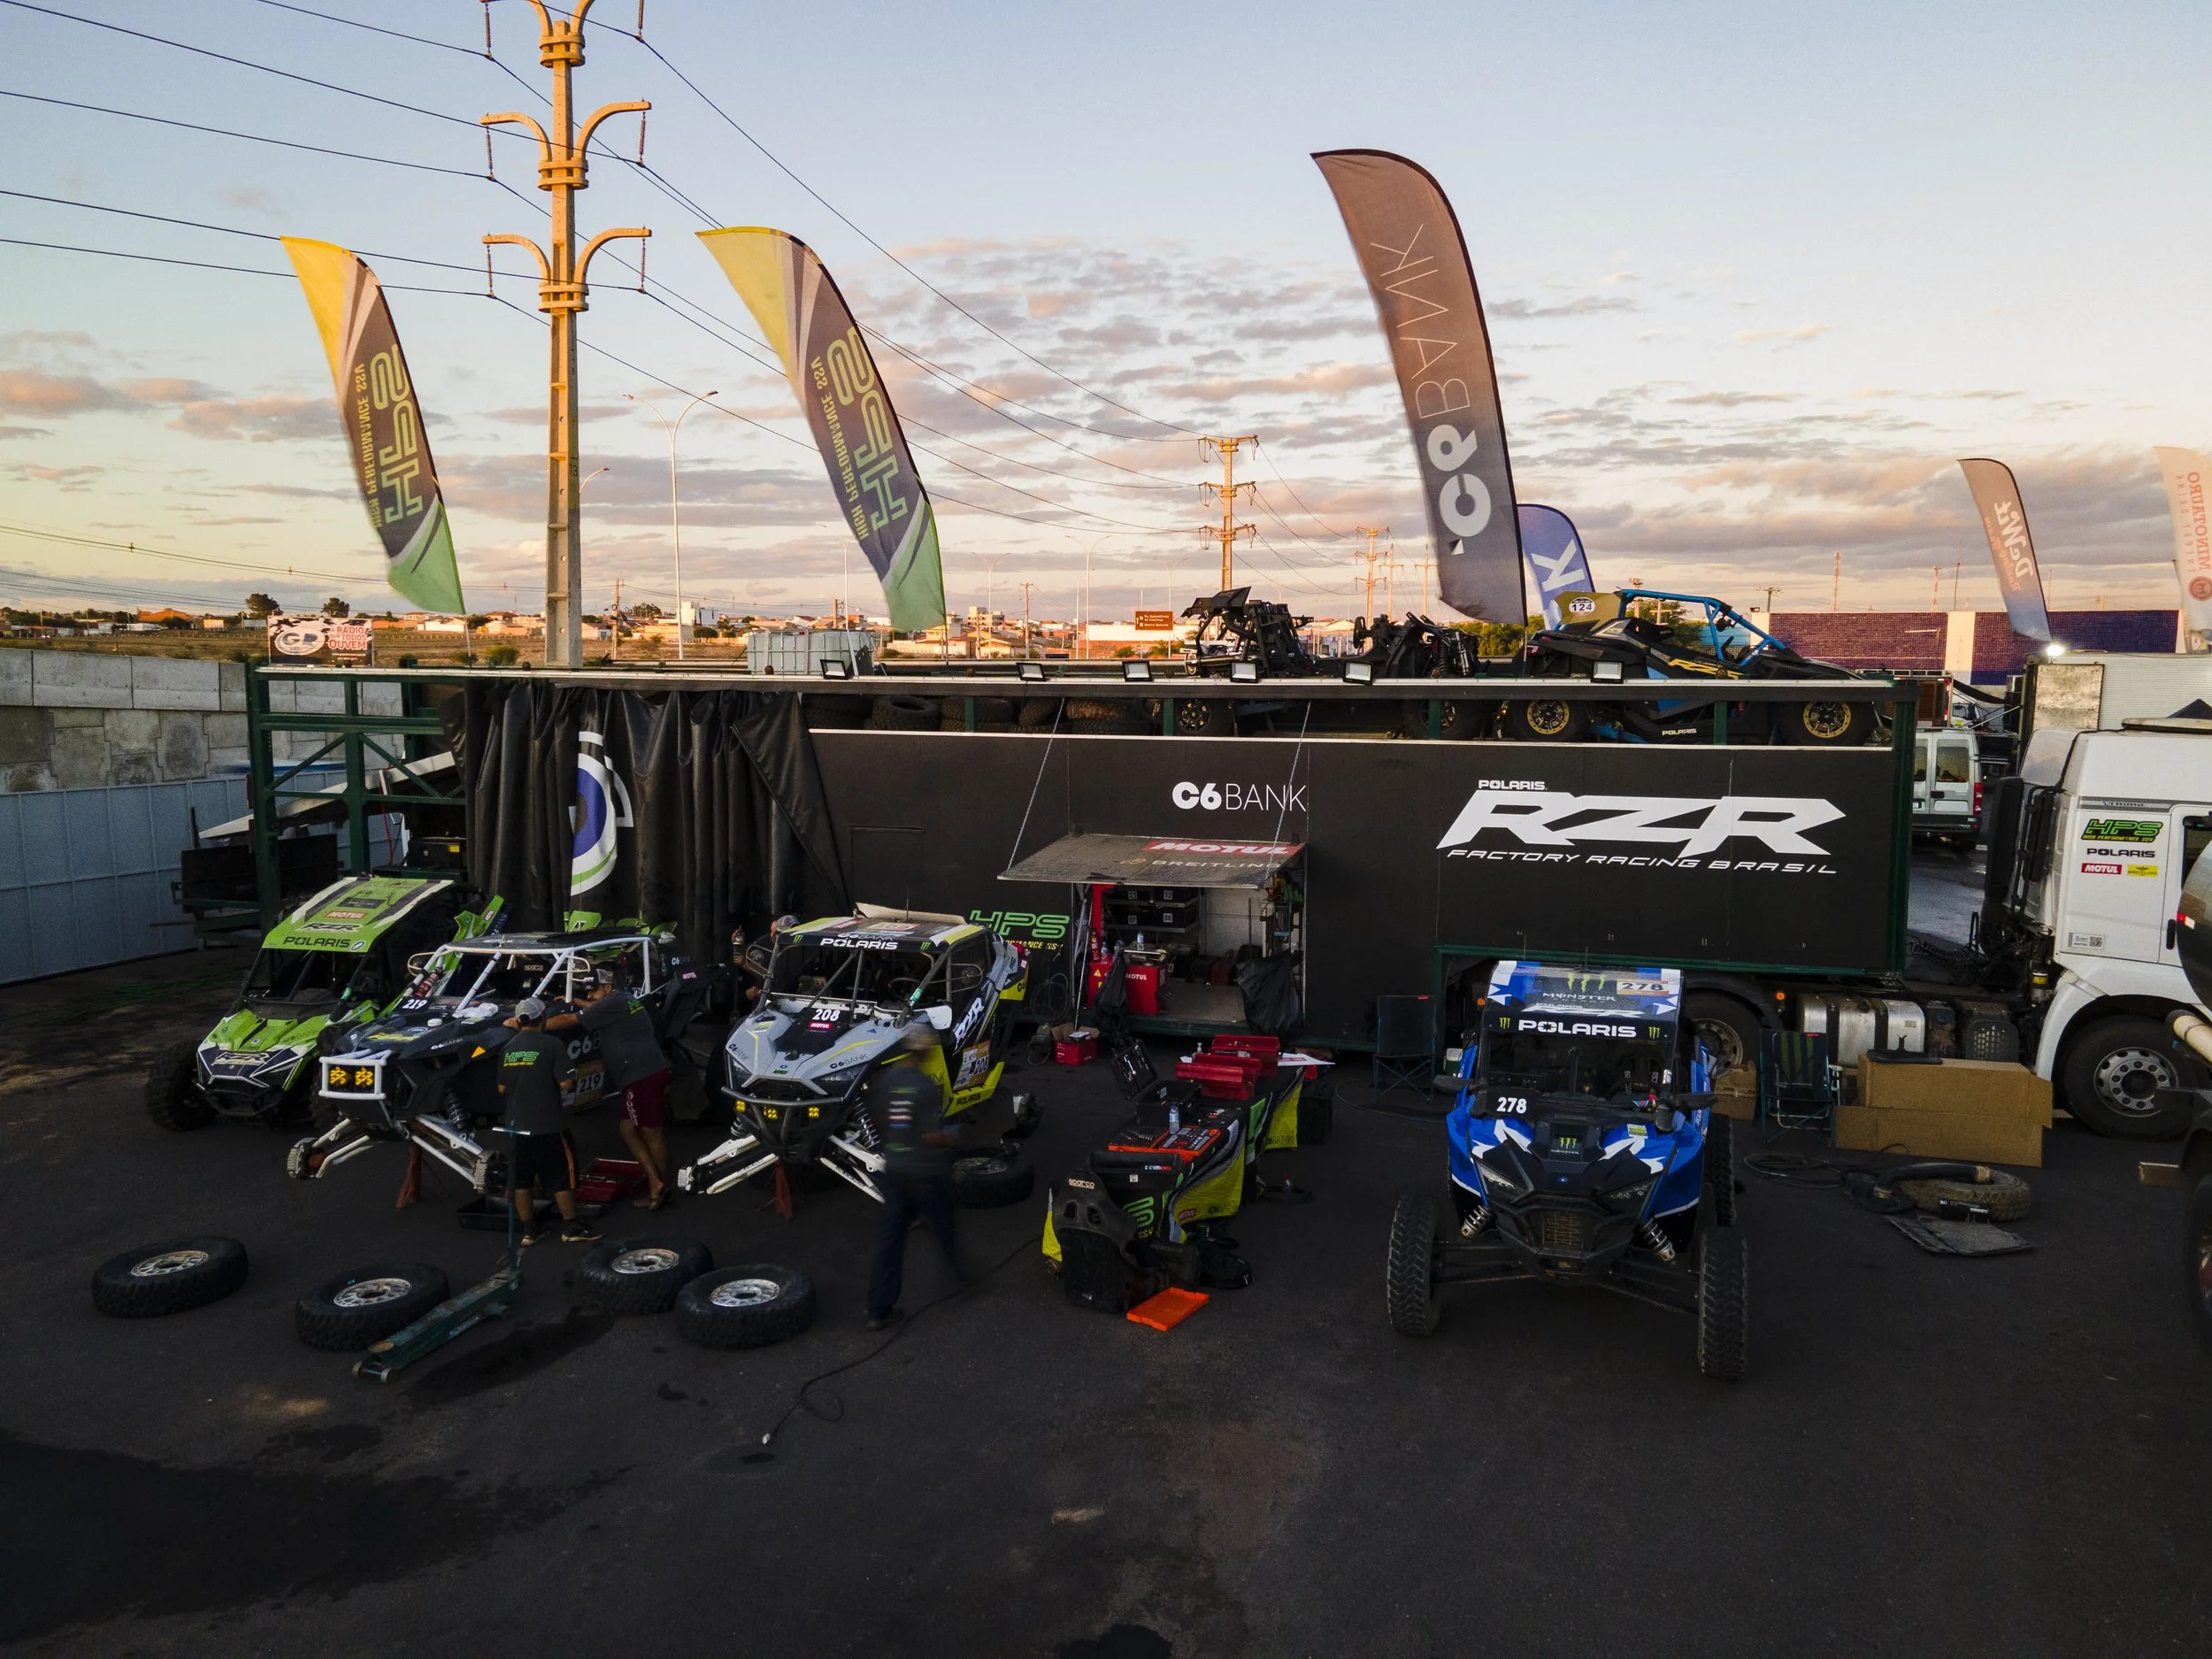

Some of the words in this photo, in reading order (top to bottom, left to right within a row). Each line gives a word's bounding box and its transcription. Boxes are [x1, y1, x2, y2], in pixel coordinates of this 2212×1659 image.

[1571, 603, 1593, 612] 124
[1479, 780, 1546, 790] POLARIS
[1436, 789, 1847, 858] RZR
[2085, 819, 2162, 837] HPS
[1149, 842, 1289, 855] MOTUL
[2086, 849, 2155, 858] POLARIS
[1447, 849, 1580, 864] FACTORY
[1586, 855, 1701, 869] RACING
[1708, 860, 1837, 874] BRASIL
[2085, 864, 2118, 873] MOTUL
[283, 936, 351, 949] POLARIS
[820, 937, 898, 950] POLARIS
[1621, 982, 1664, 991] 278
[402, 999, 427, 1010] 219
[812, 1008, 841, 1022] 208
[1517, 1019, 1637, 1038] POLARIS
[580, 1074, 600, 1092] 219
[1496, 1096, 1527, 1114] 278
[1068, 1179, 1095, 1190] sparco
